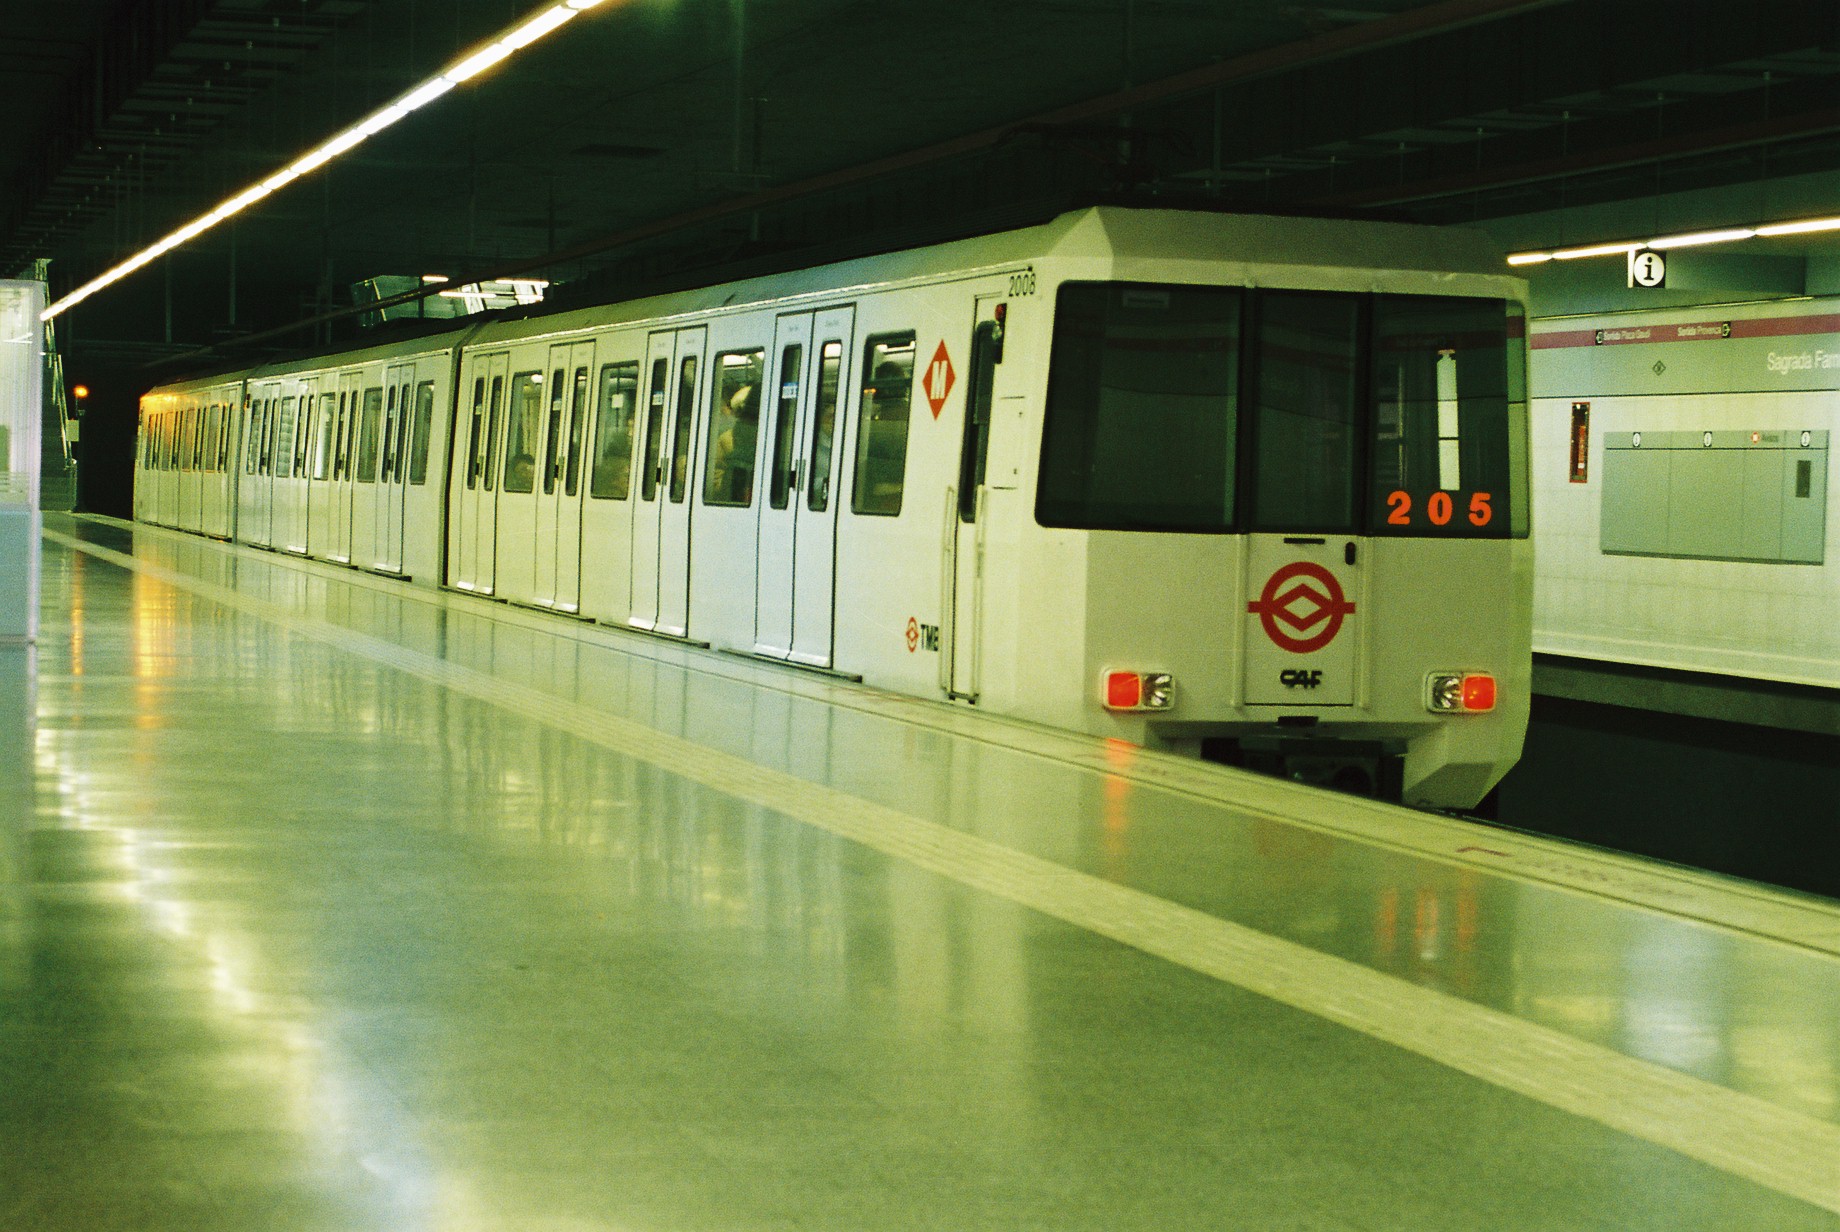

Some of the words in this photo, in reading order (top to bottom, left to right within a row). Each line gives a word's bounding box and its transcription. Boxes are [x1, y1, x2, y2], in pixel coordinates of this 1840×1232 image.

[1767, 352, 1812, 375] Sagrada
[930, 360, 948, 400] M
[1387, 490, 1492, 527] 205
[1280, 669, 1322, 689] CAF
